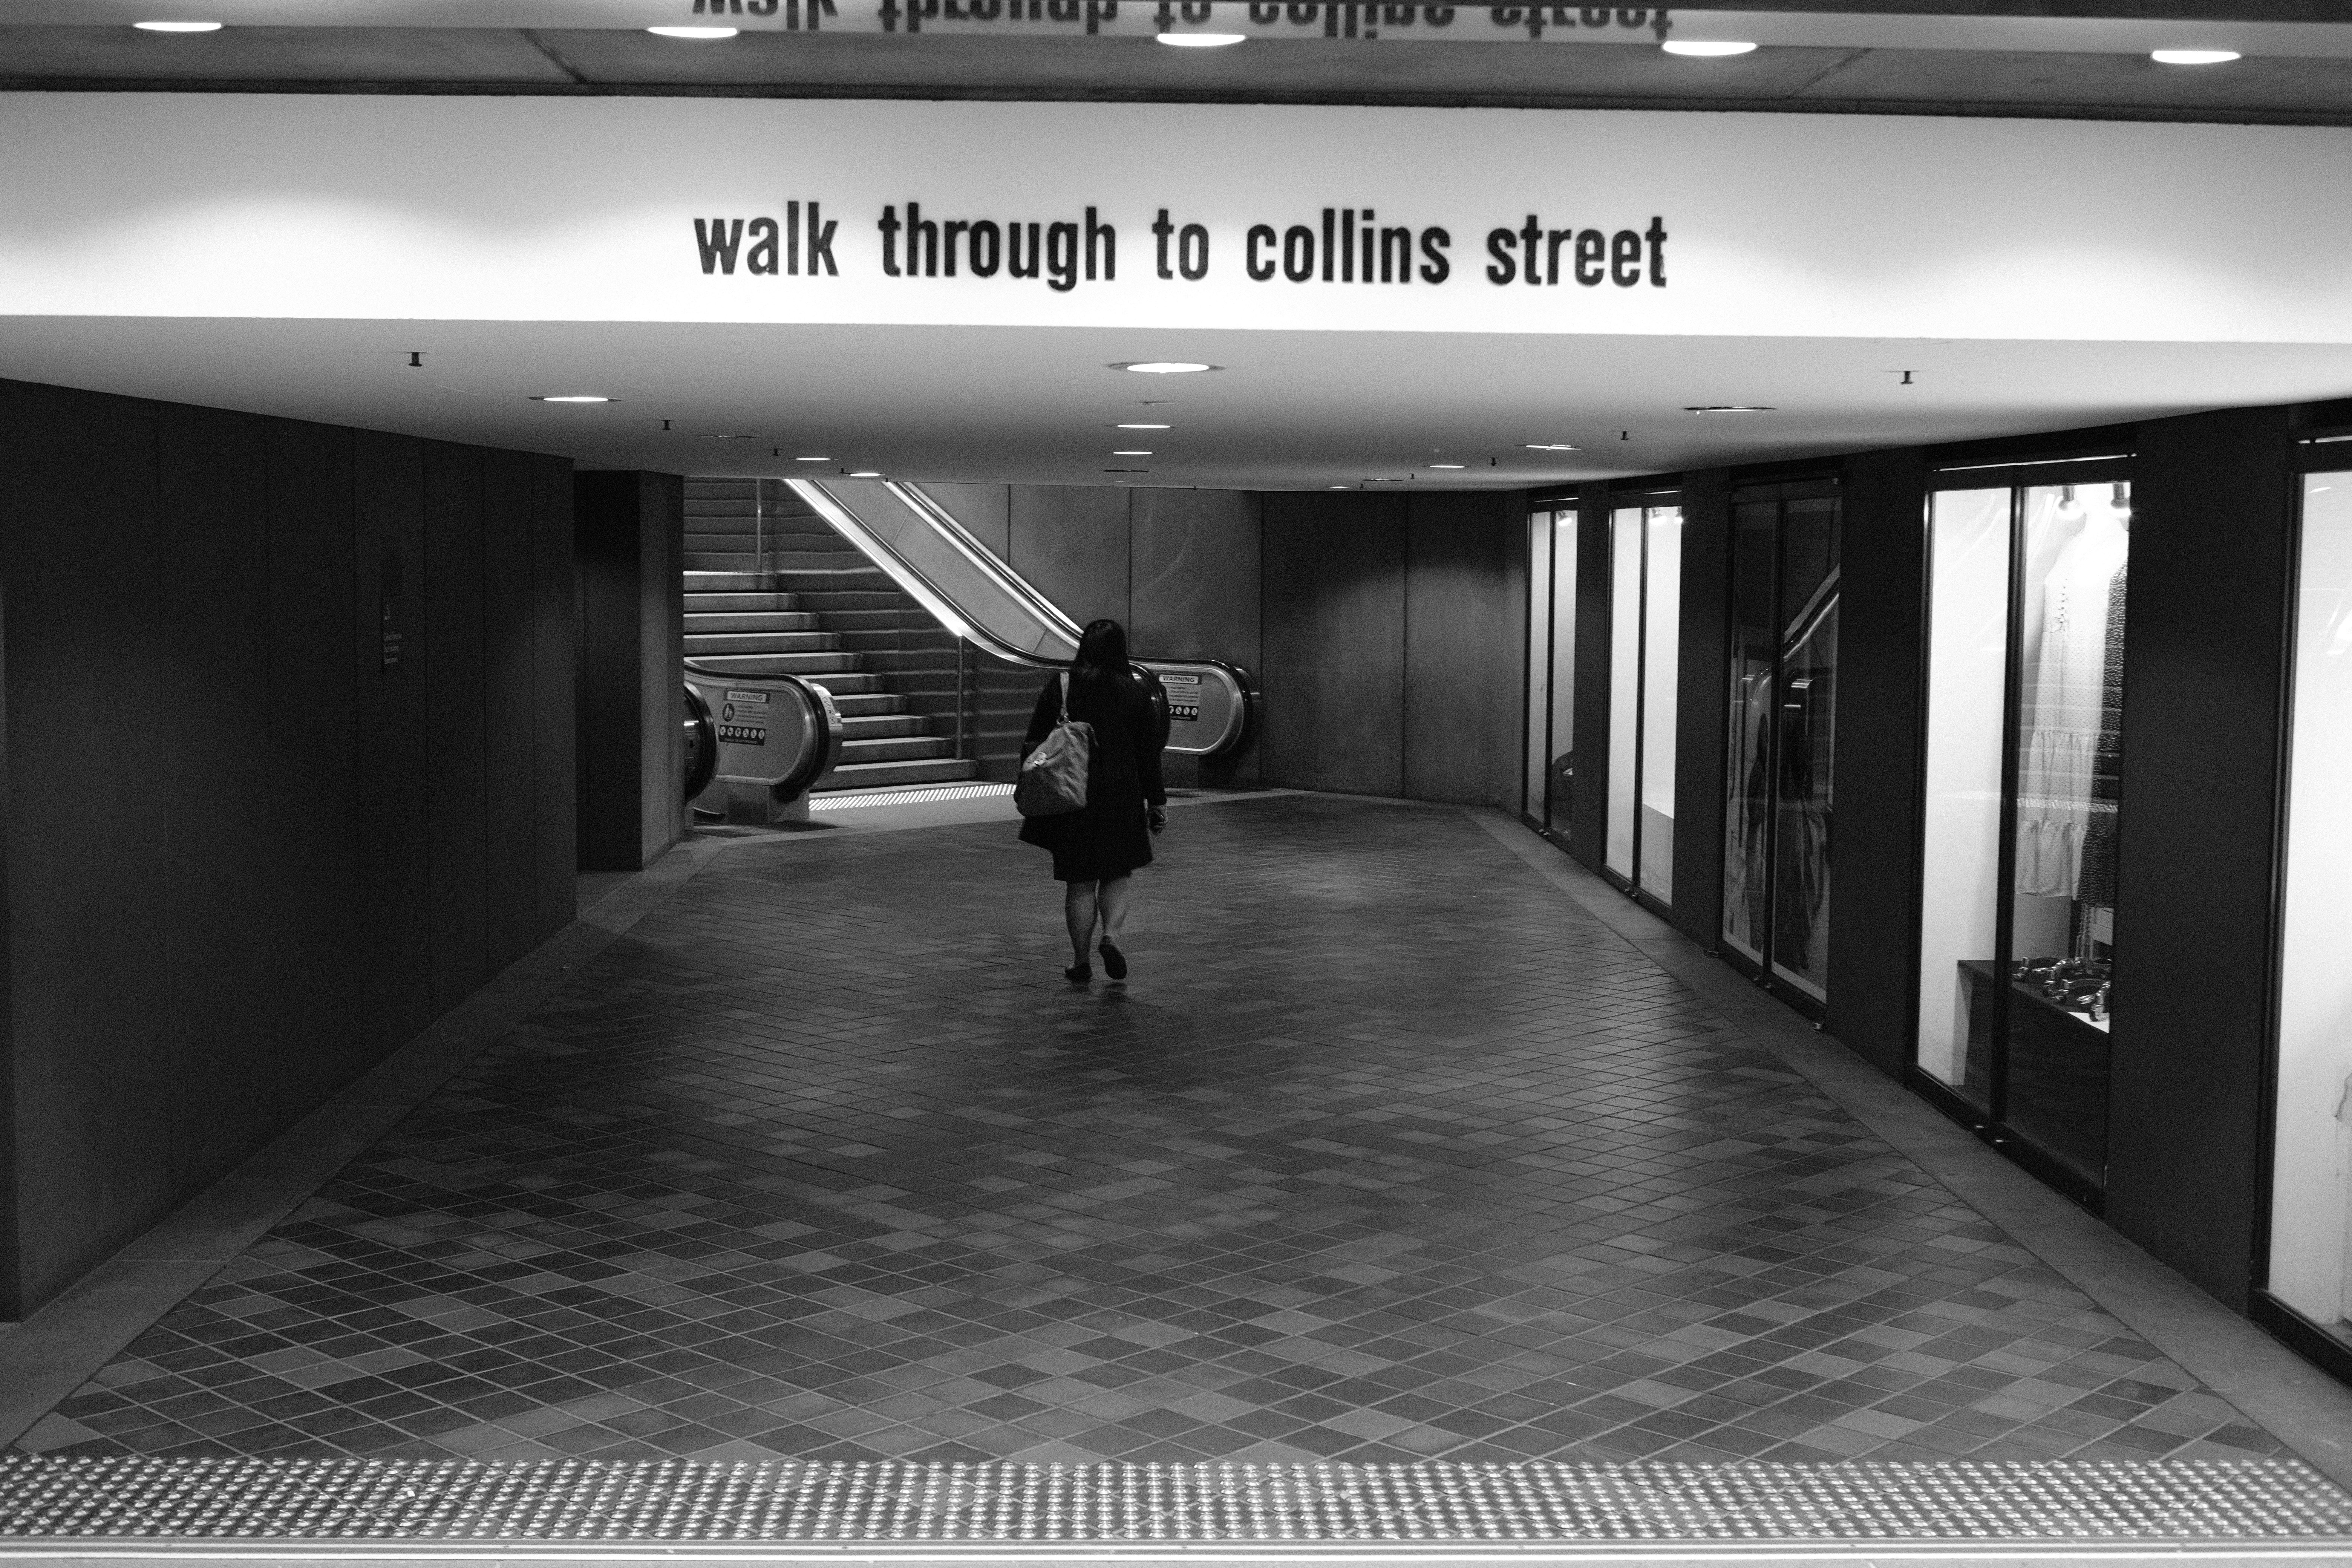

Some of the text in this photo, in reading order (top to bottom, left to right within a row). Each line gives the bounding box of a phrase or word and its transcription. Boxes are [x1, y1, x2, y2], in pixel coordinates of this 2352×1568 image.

[694, 201, 1667, 292] walk through to collins street
[731, 692, 763, 701] WARNING
